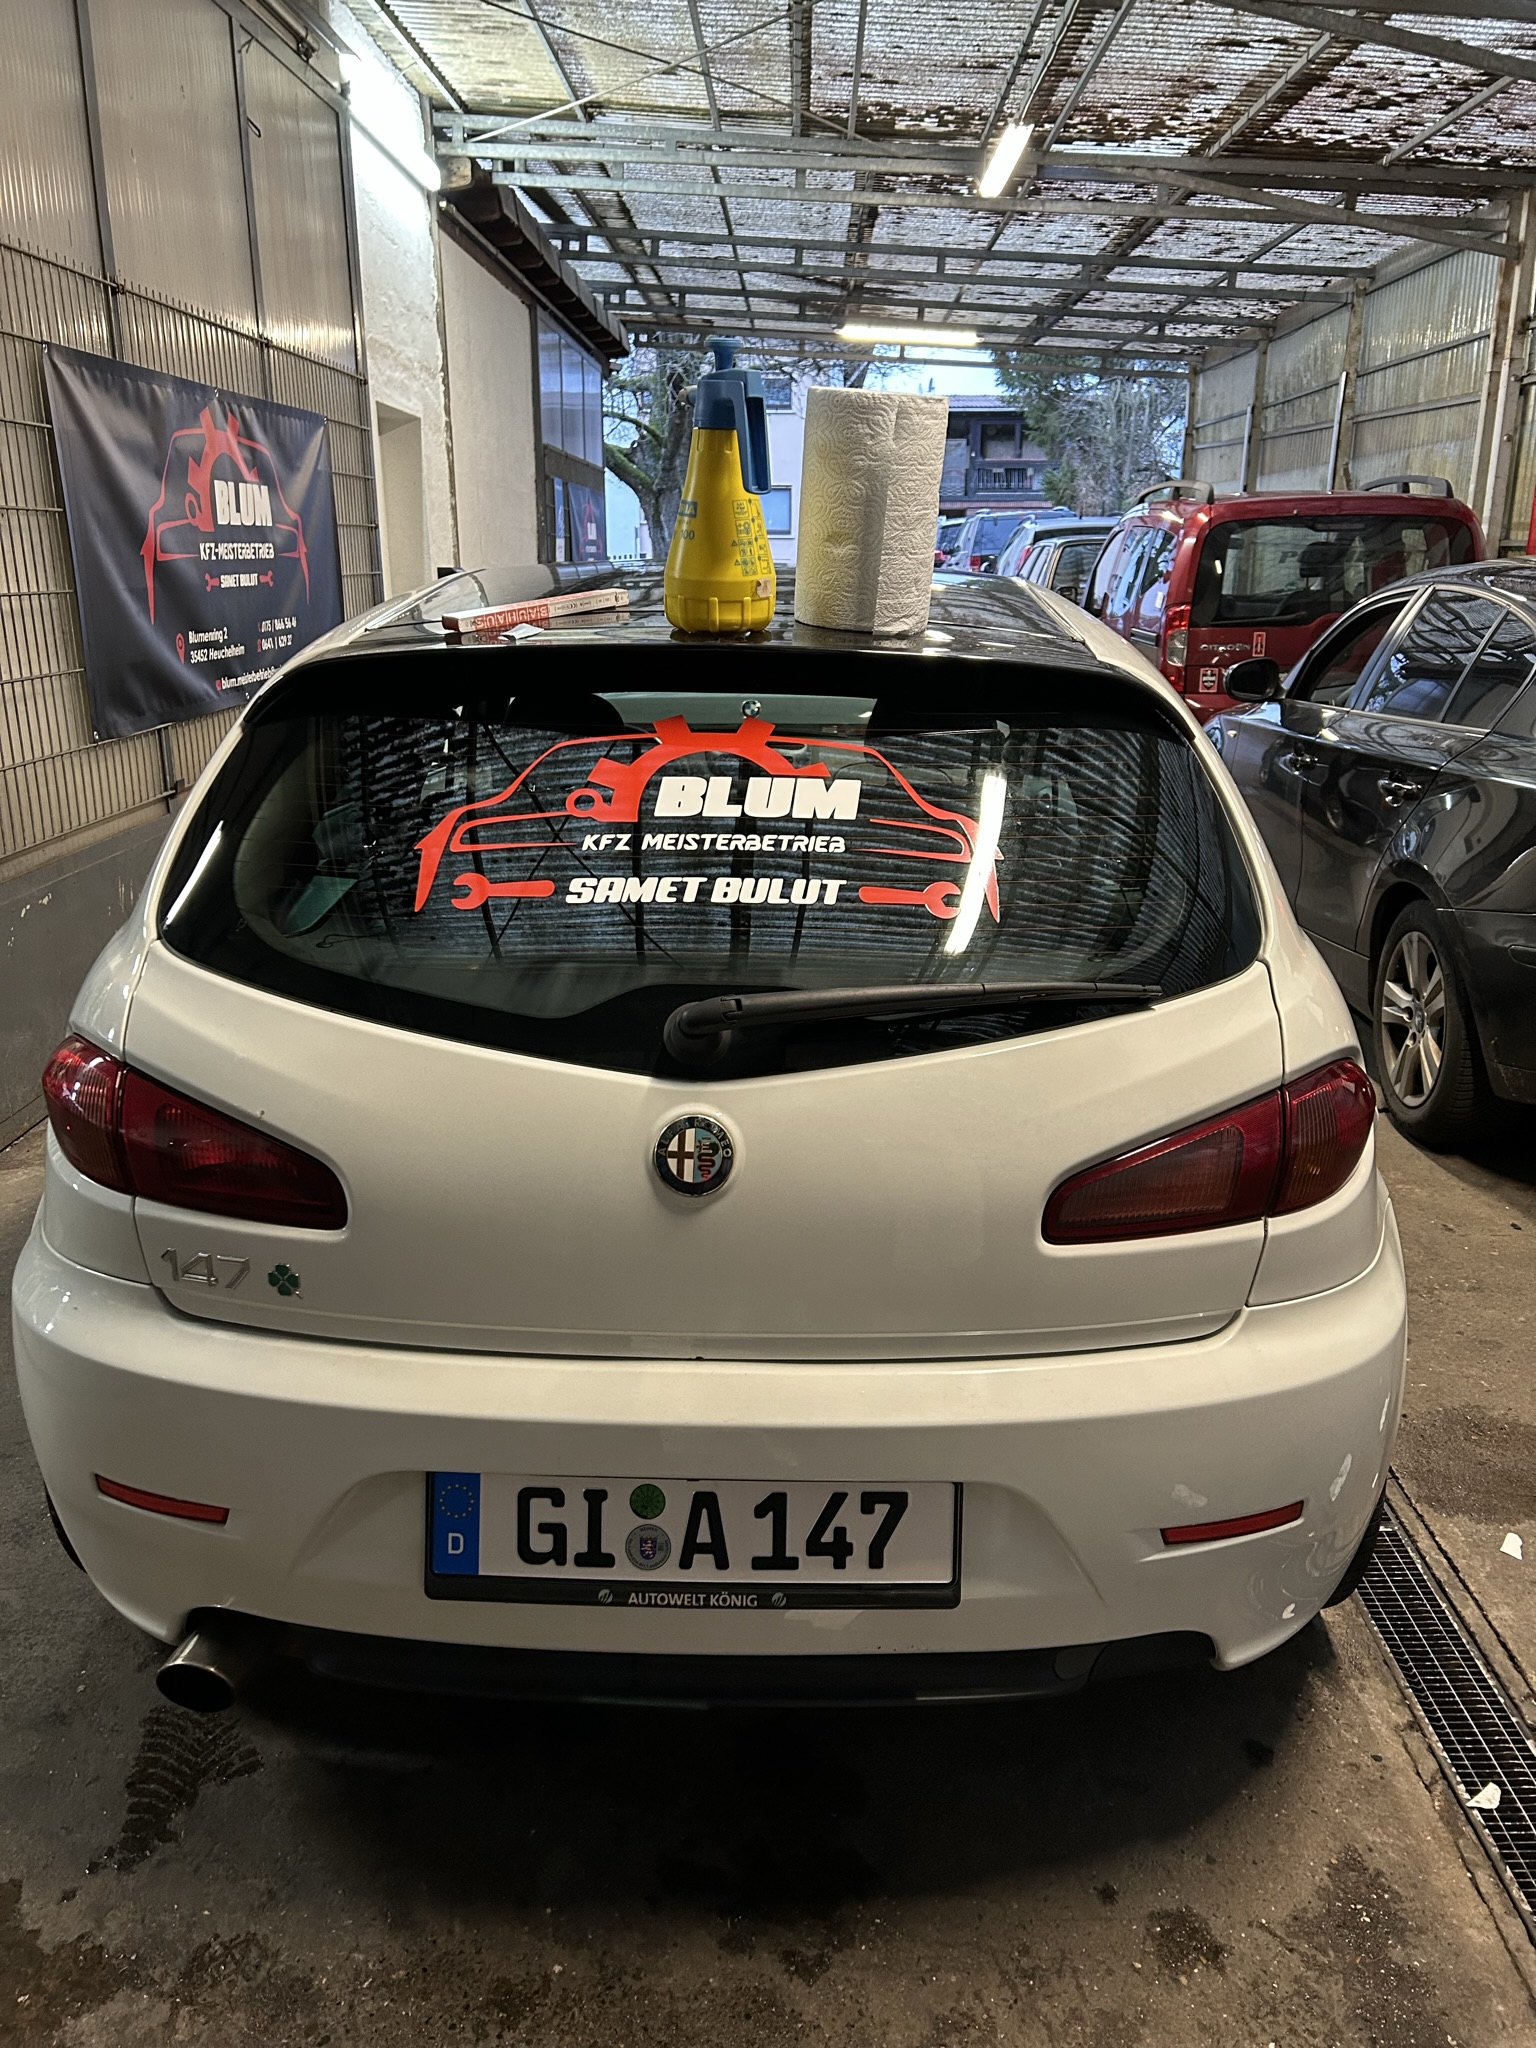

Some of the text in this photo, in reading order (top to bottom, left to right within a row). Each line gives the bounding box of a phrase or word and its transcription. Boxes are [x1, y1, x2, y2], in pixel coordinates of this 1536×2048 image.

[213, 480, 273, 527] BLUM
[199, 543, 275, 560] KFZ-MEISTERBETRIEB
[220, 573, 258, 588] SAMET BULUT
[474, 604, 549, 628] BAUHAUS
[188, 626, 228, 644] Blumenring 2
[190, 644, 246, 664] 35452 Heuchelheim
[652, 775, 862, 820] BLUM
[581, 834, 846, 854] KFZ MEISTERBETRIEB
[565, 876, 848, 906] SAMET BULUT
[160, 1247, 250, 1290] 147
[516, 1486, 616, 1568] GI
[678, 1491, 730, 1571] A
[751, 1491, 909, 1571] 147
[446, 1532, 464, 1555] D
[627, 1590, 758, 1608] AUTOWELT KÖNIG
